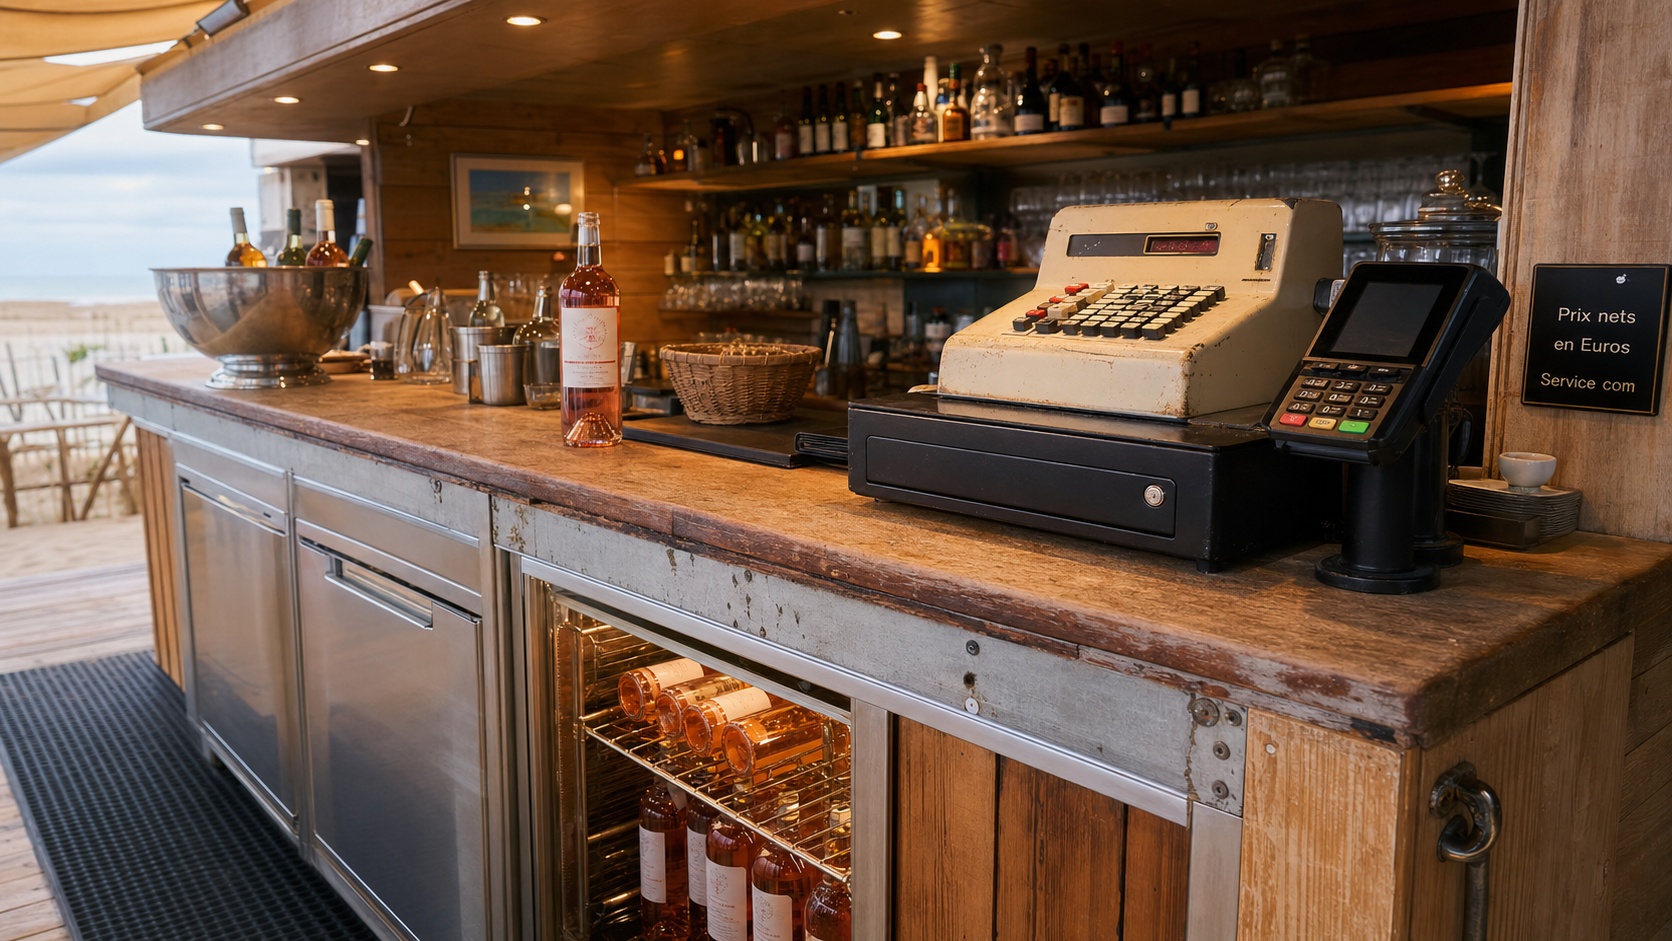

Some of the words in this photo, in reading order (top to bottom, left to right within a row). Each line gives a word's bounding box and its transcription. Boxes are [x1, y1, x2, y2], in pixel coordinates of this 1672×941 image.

[1558, 307, 1591, 323] Prix
[1598, 309, 1636, 324] nets
[1554, 340, 1574, 351] en
[1580, 337, 1630, 354] Euros
[1540, 372, 1596, 390] Service
[1602, 380, 1636, 393] com
